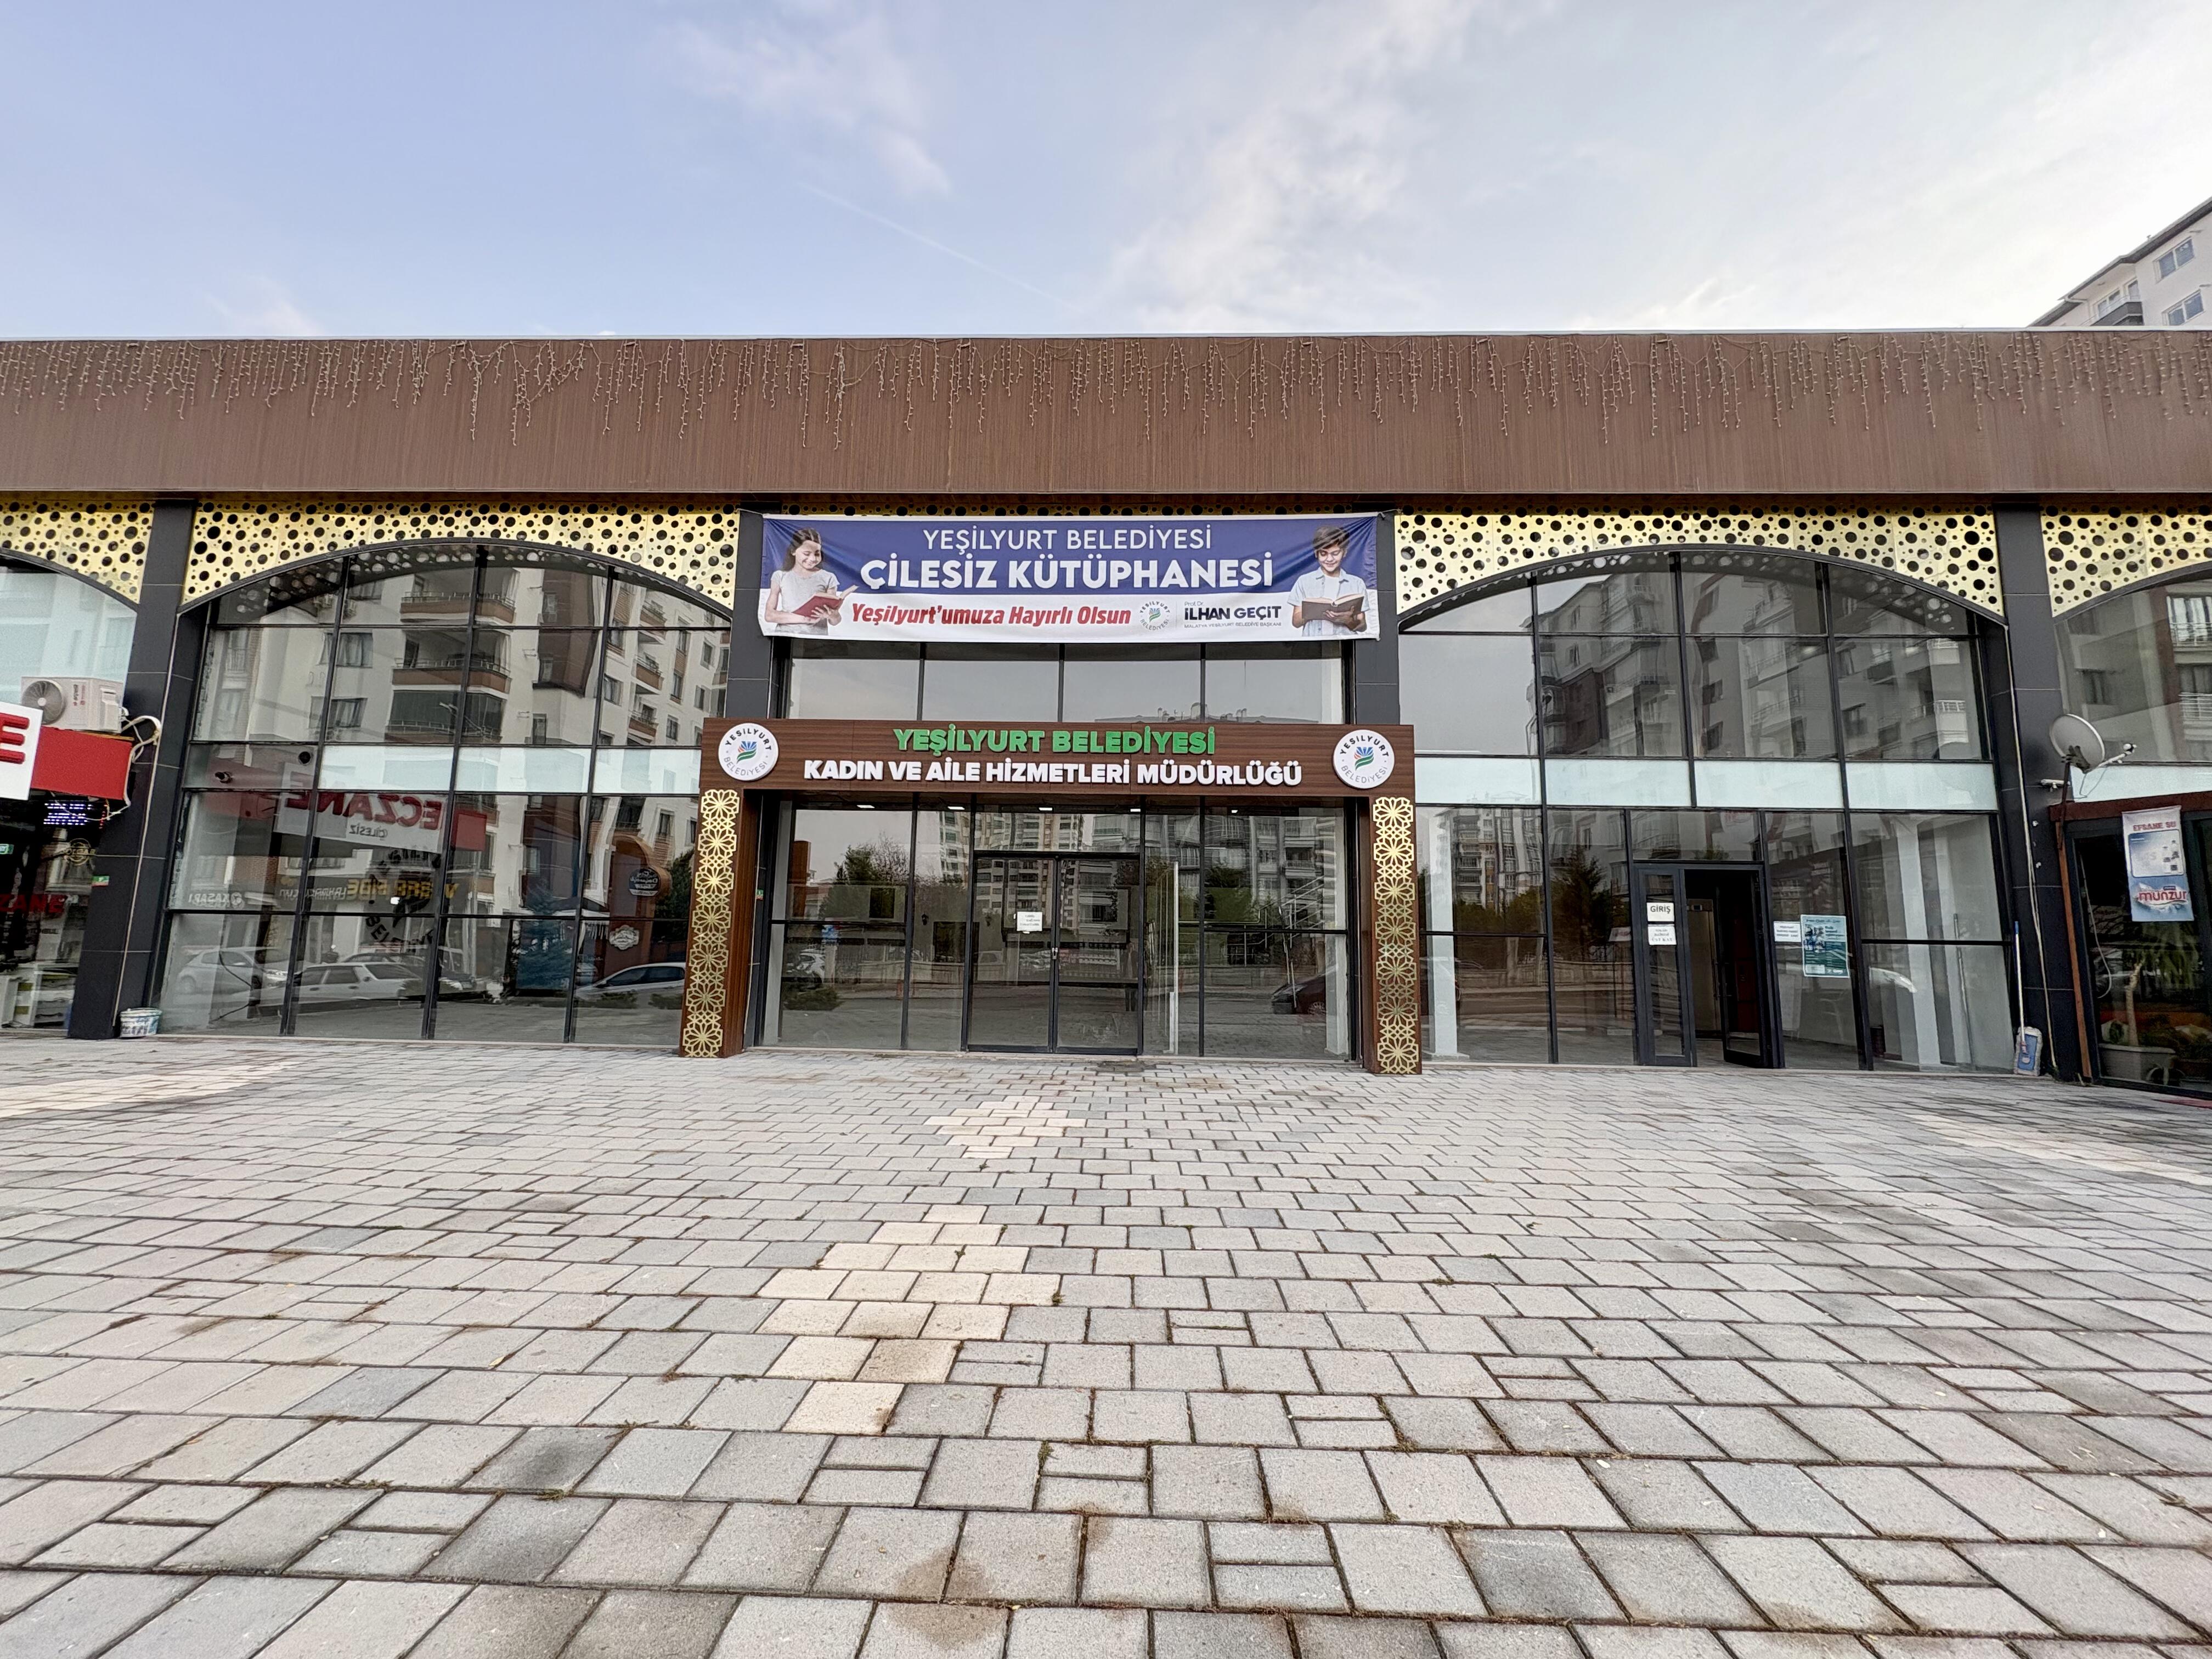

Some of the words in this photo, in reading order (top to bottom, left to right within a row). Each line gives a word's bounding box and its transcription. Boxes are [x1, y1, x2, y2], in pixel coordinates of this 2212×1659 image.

[923, 525, 1057, 555] YEŞİLYURT
[1066, 524, 1211, 550] BELEDİYESİ
[860, 552, 998, 590] ÇİLESİZ
[1008, 551, 1273, 589] KÜTÜPHANESİ
[1008, 606, 1073, 627] Hayırlı
[1077, 606, 1131, 624] Olsun
[1184, 607, 1231, 620] İLHAN
[1234, 606, 1282, 620] GEÇİT
[894, 723, 1045, 757] YEŞİLYURT
[1052, 725, 1216, 755] BELEDİYESİ
[804, 760, 884, 781] KADIN
[888, 761, 922, 781] VE
[926, 757, 981, 782] AİLE
[986, 757, 1130, 785] HİZMETLERİ
[1137, 759, 1302, 786] MÜDÜRLÜĞÜ
[2138, 890, 2187, 901] munzur
[1650, 904, 1671, 915] GİRİŞ
